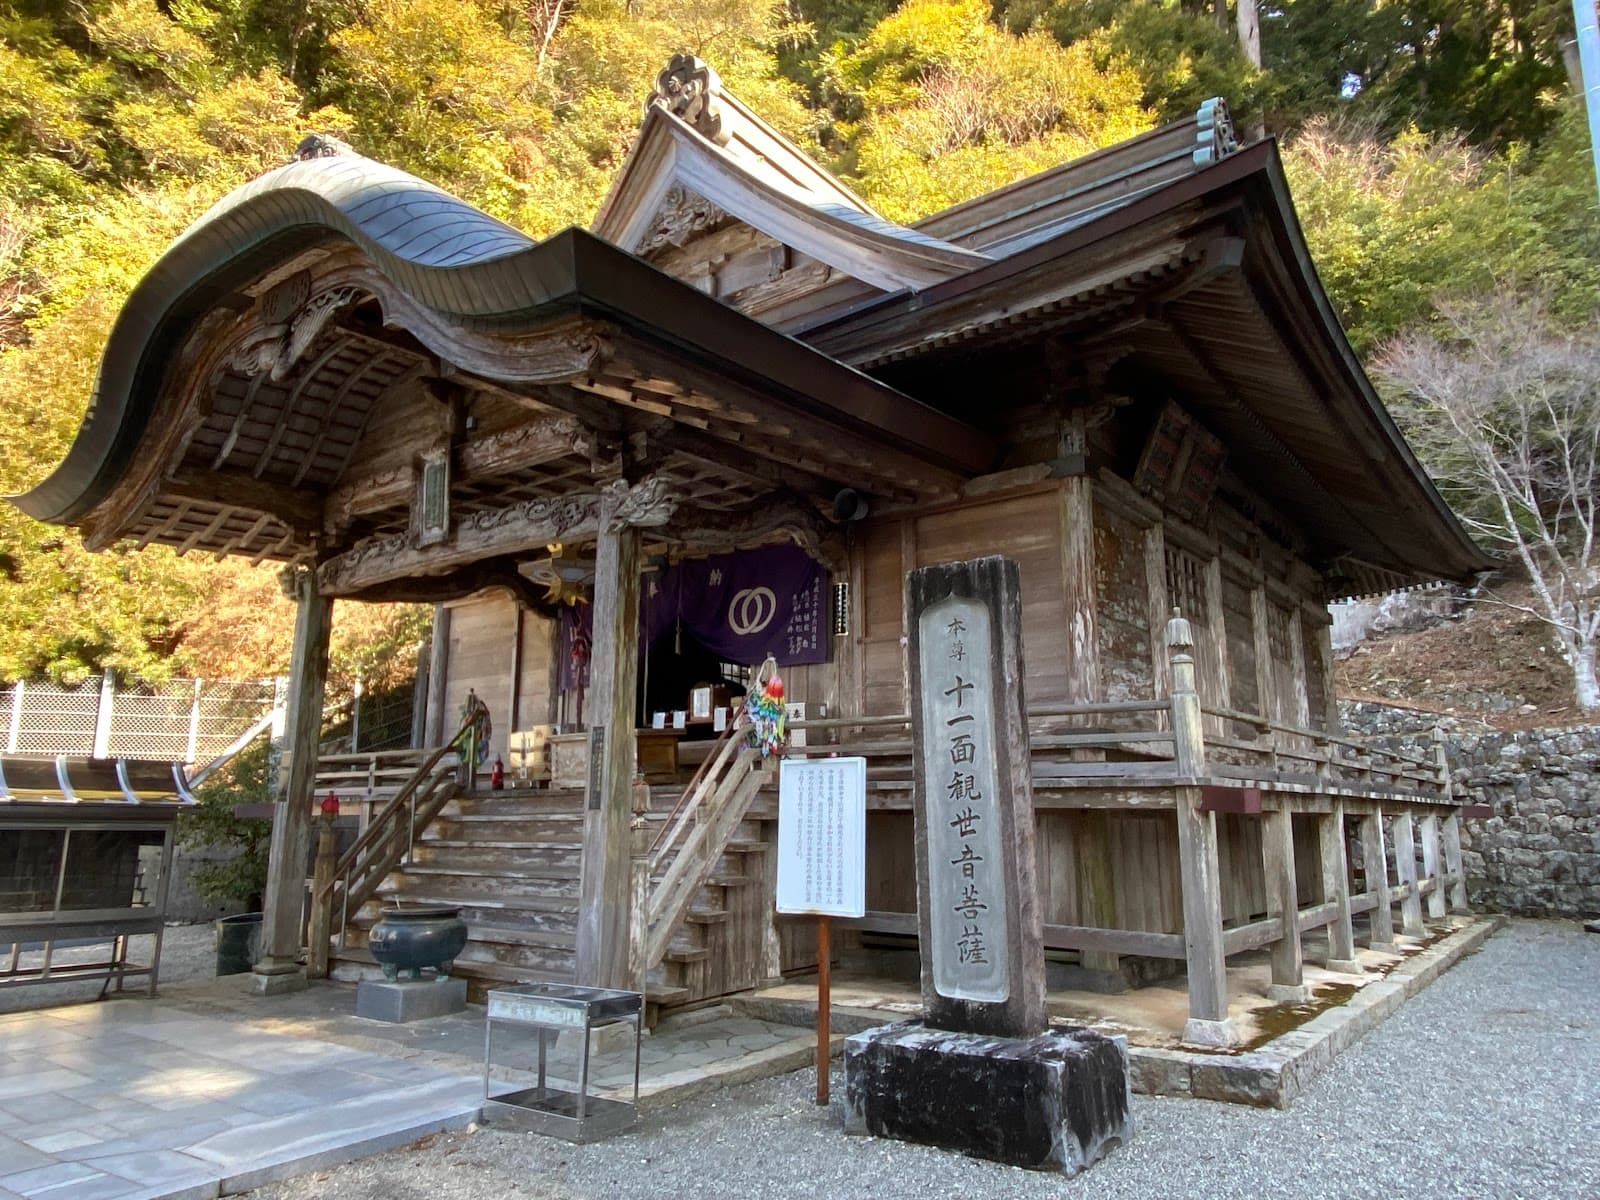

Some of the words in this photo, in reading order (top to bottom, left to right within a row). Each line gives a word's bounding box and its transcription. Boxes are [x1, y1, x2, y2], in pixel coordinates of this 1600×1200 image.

[946, 617, 966, 660] 本尊
[944, 676, 988, 965] 十一面観世音菩薩
